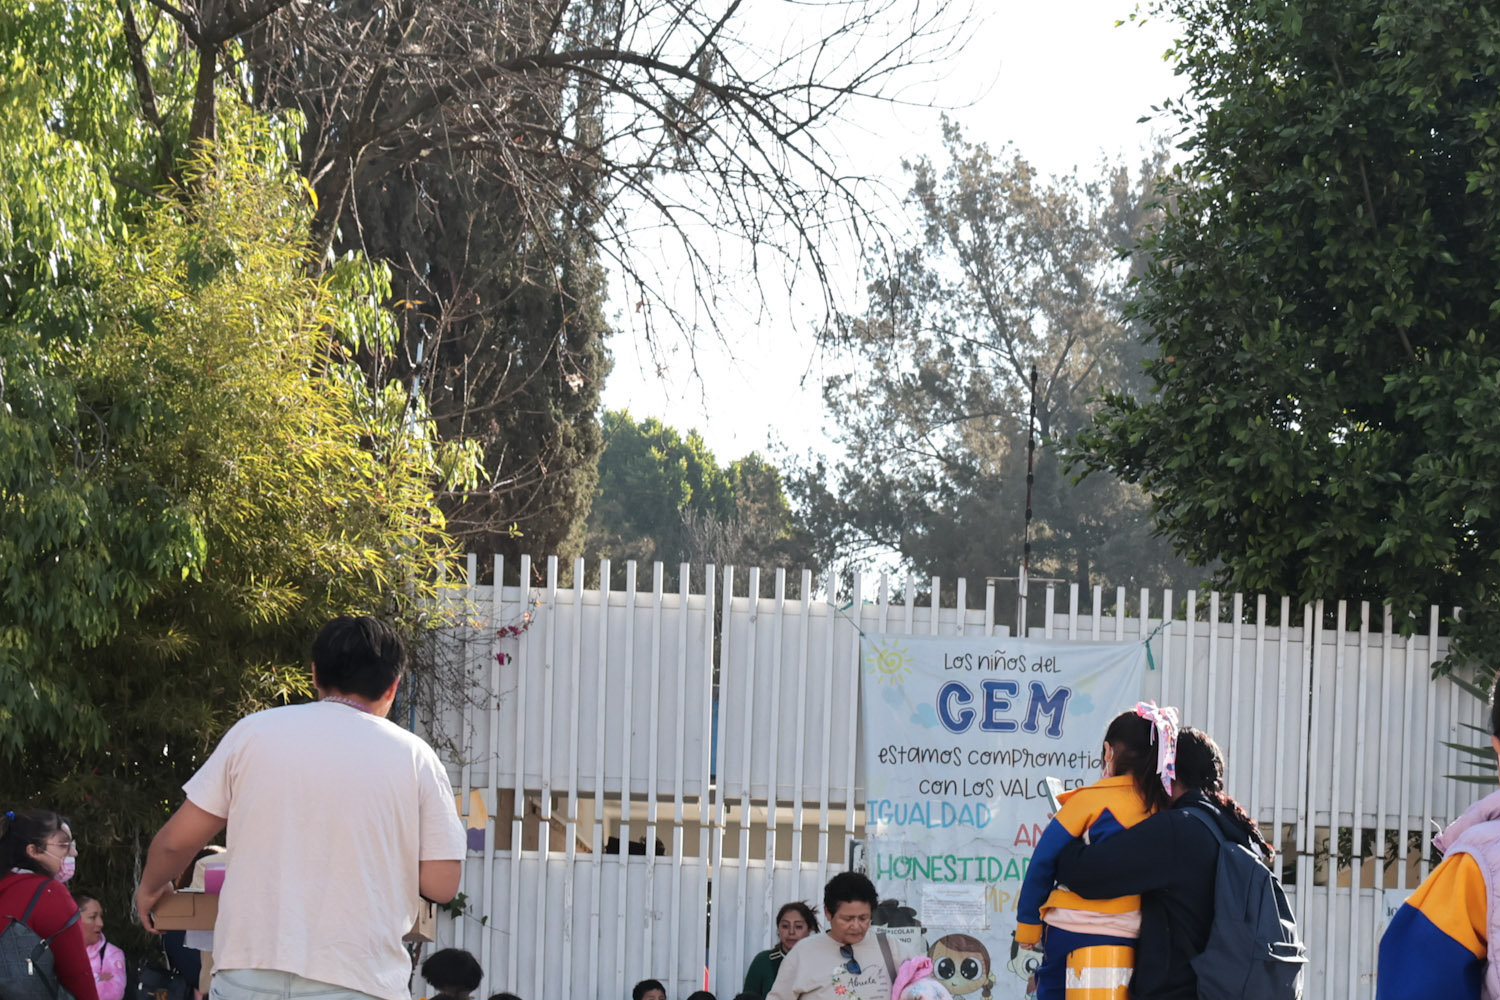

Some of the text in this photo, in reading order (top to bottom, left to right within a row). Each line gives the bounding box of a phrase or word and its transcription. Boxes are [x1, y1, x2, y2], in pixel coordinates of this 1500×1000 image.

[944, 653, 973, 671] Los
[978, 650, 1027, 673] niños
[936, 679, 1072, 739] CEM
[878, 745, 1103, 769] estamos comprometid
[919, 778, 957, 796] con
[1000, 778, 1084, 800] VALOES
[866, 799, 992, 829] IGUALDAD
